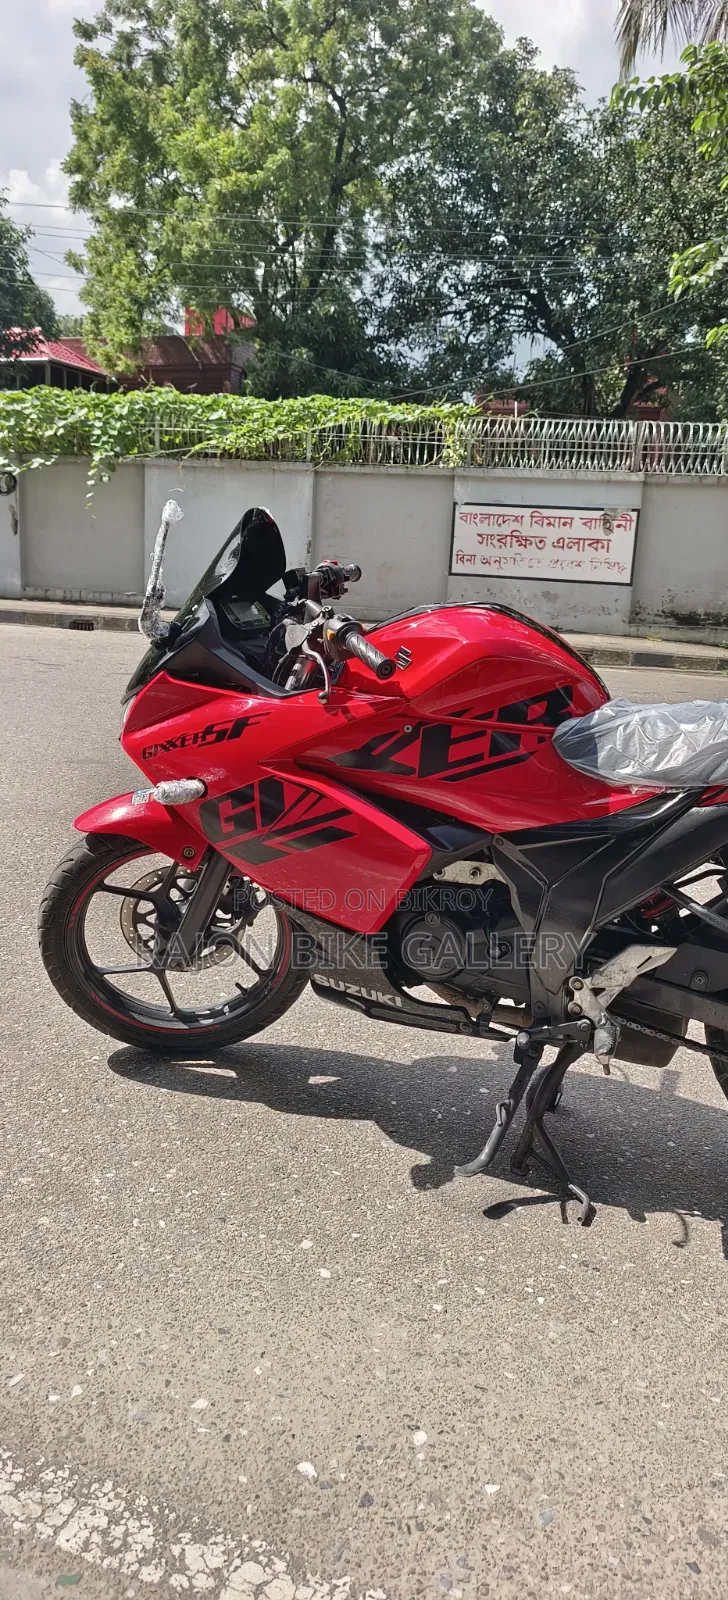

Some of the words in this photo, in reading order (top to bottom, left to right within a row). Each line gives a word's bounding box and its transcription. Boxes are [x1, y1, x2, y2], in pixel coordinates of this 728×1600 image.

[459, 512, 524, 528] বাংলাদেশ
[529, 510, 575, 529] বিমান
[579, 513, 634, 534] বাহিনী
[477, 529, 547, 550] সংরক্ষিত
[552, 537, 612, 553] এলাকা
[455, 549, 477, 566] বিনা
[141, 731, 207, 760] GIXXER
[197, 710, 275, 748] SF
[313, 974, 402, 1007] SUZUKI
